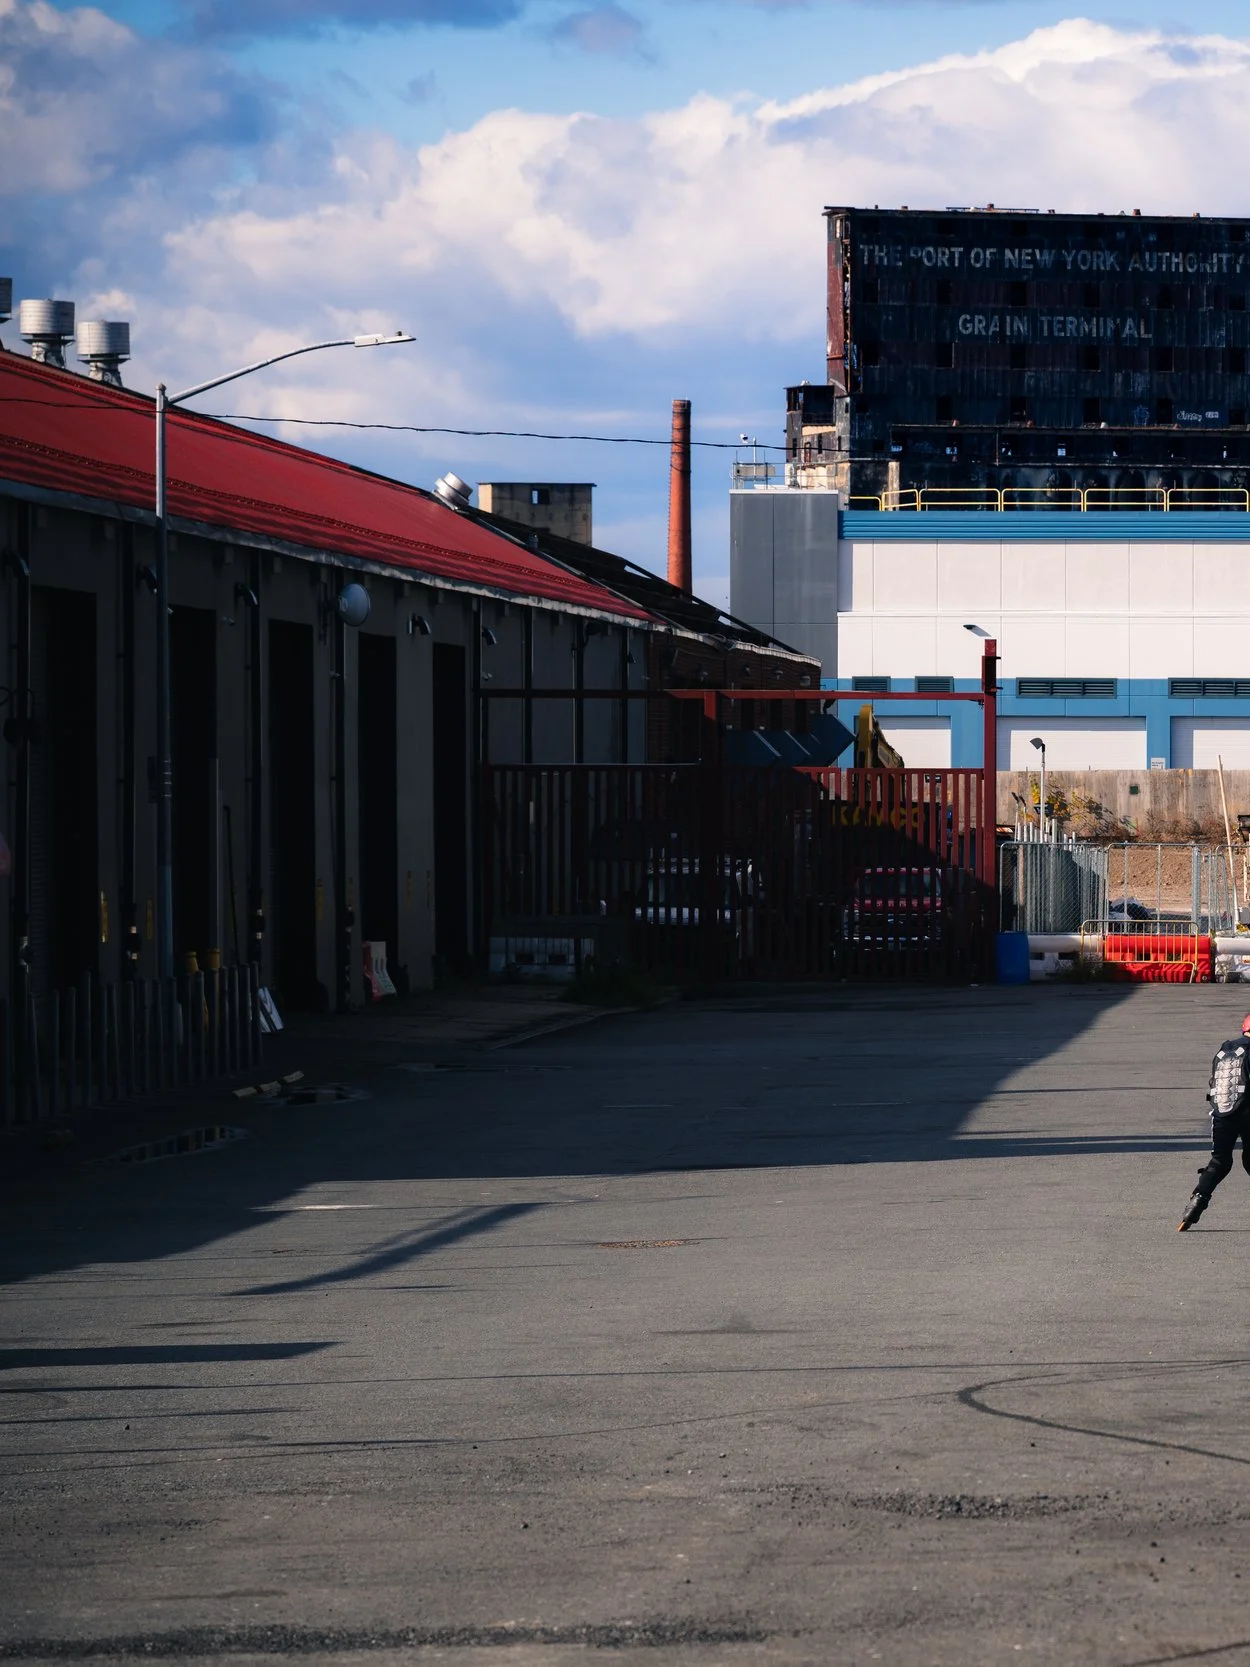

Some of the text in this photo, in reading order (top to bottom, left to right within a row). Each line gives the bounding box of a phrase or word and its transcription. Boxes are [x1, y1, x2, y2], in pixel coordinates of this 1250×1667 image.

[859, 244, 903, 266] THE
[970, 247, 997, 268] OF
[1004, 247, 1056, 269] NEW
[1062, 249, 1120, 271] YORK
[958, 313, 1152, 338] GRAIN TERMINAL
